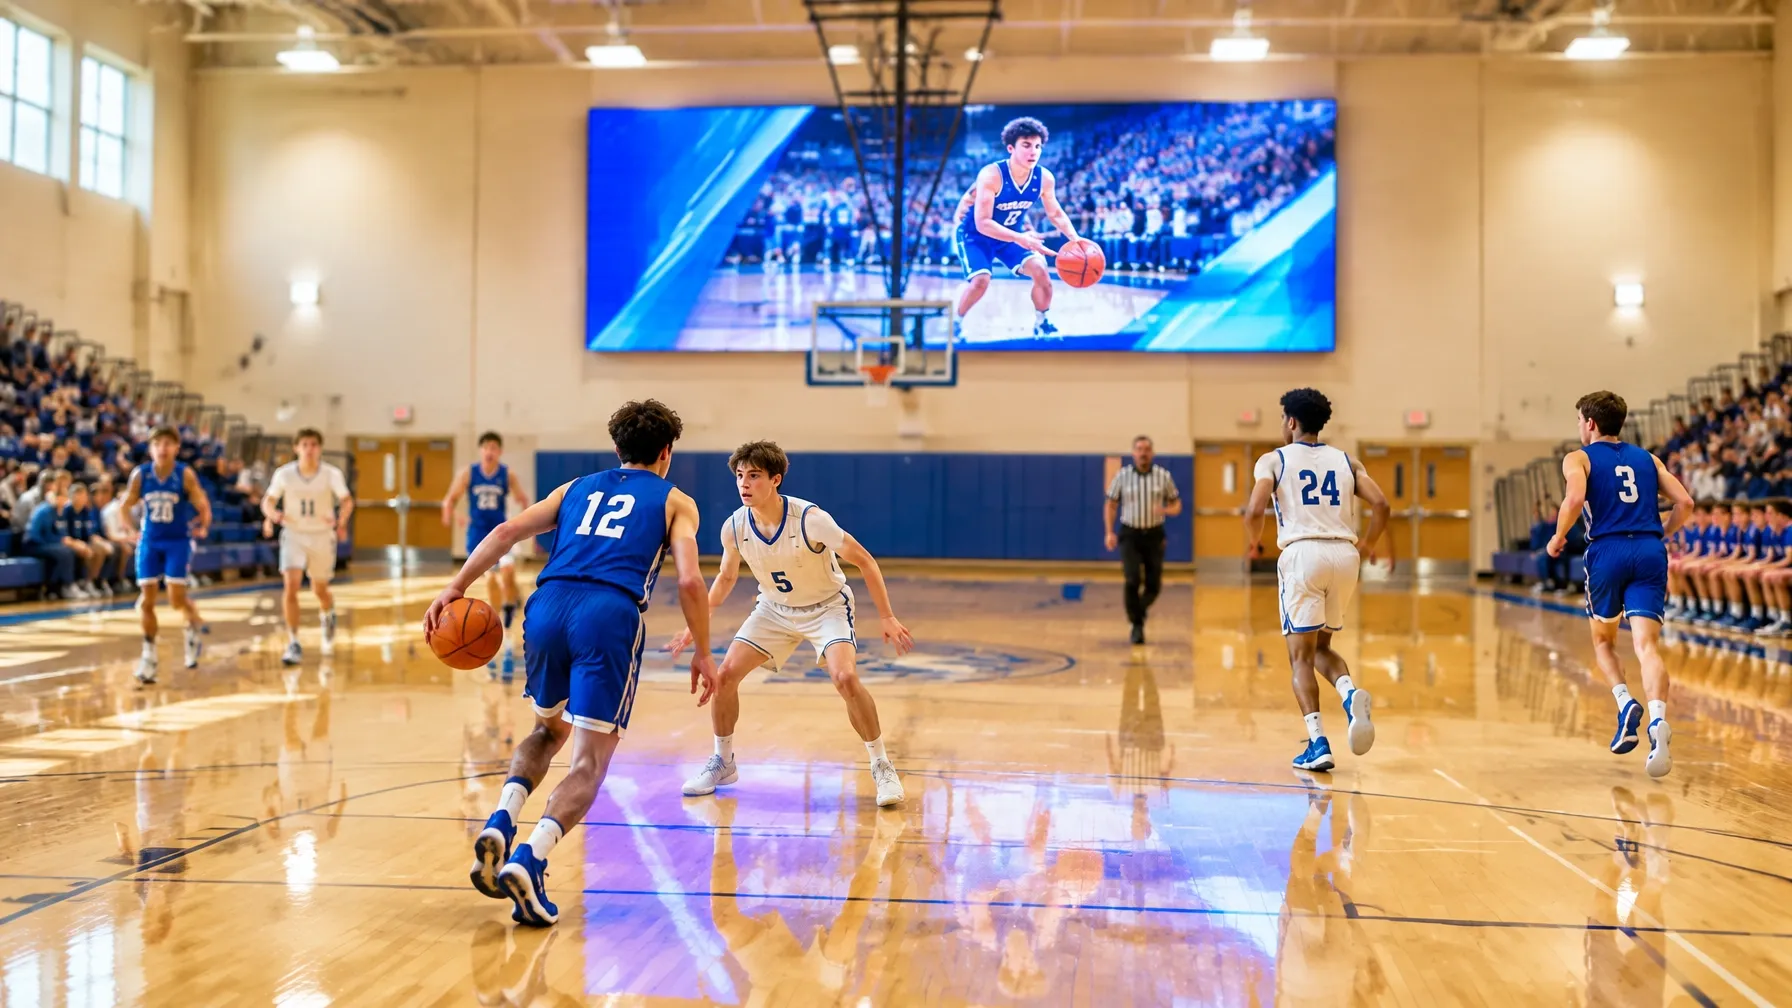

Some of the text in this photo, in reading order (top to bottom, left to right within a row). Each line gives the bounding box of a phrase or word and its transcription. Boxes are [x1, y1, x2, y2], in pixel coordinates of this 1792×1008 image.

[1299, 469, 1340, 505] 24
[1615, 465, 1638, 503] 3
[300, 499, 315, 515] 11
[575, 491, 635, 539] 12
[771, 571, 794, 593] 5
